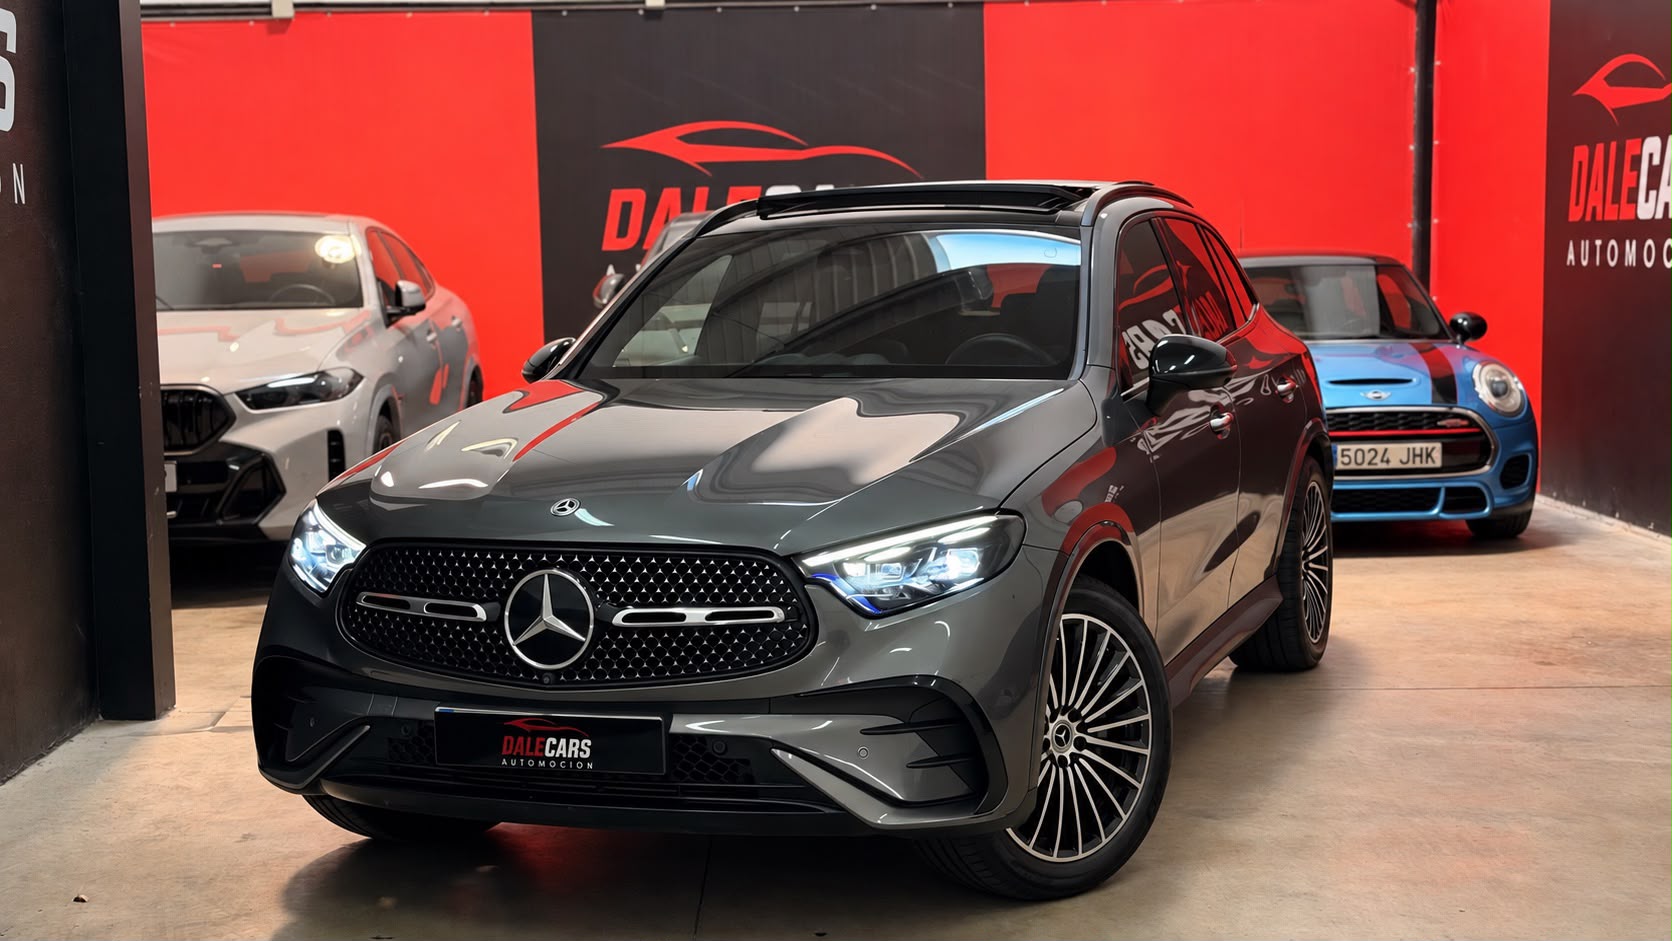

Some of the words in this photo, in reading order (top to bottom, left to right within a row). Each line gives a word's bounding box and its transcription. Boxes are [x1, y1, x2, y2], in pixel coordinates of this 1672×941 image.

[1566, 238, 1672, 269] AUTOMOC
[1340, 447, 1391, 466] 5024
[1399, 446, 1437, 465] JHK
[502, 735, 592, 758] DALECARS
